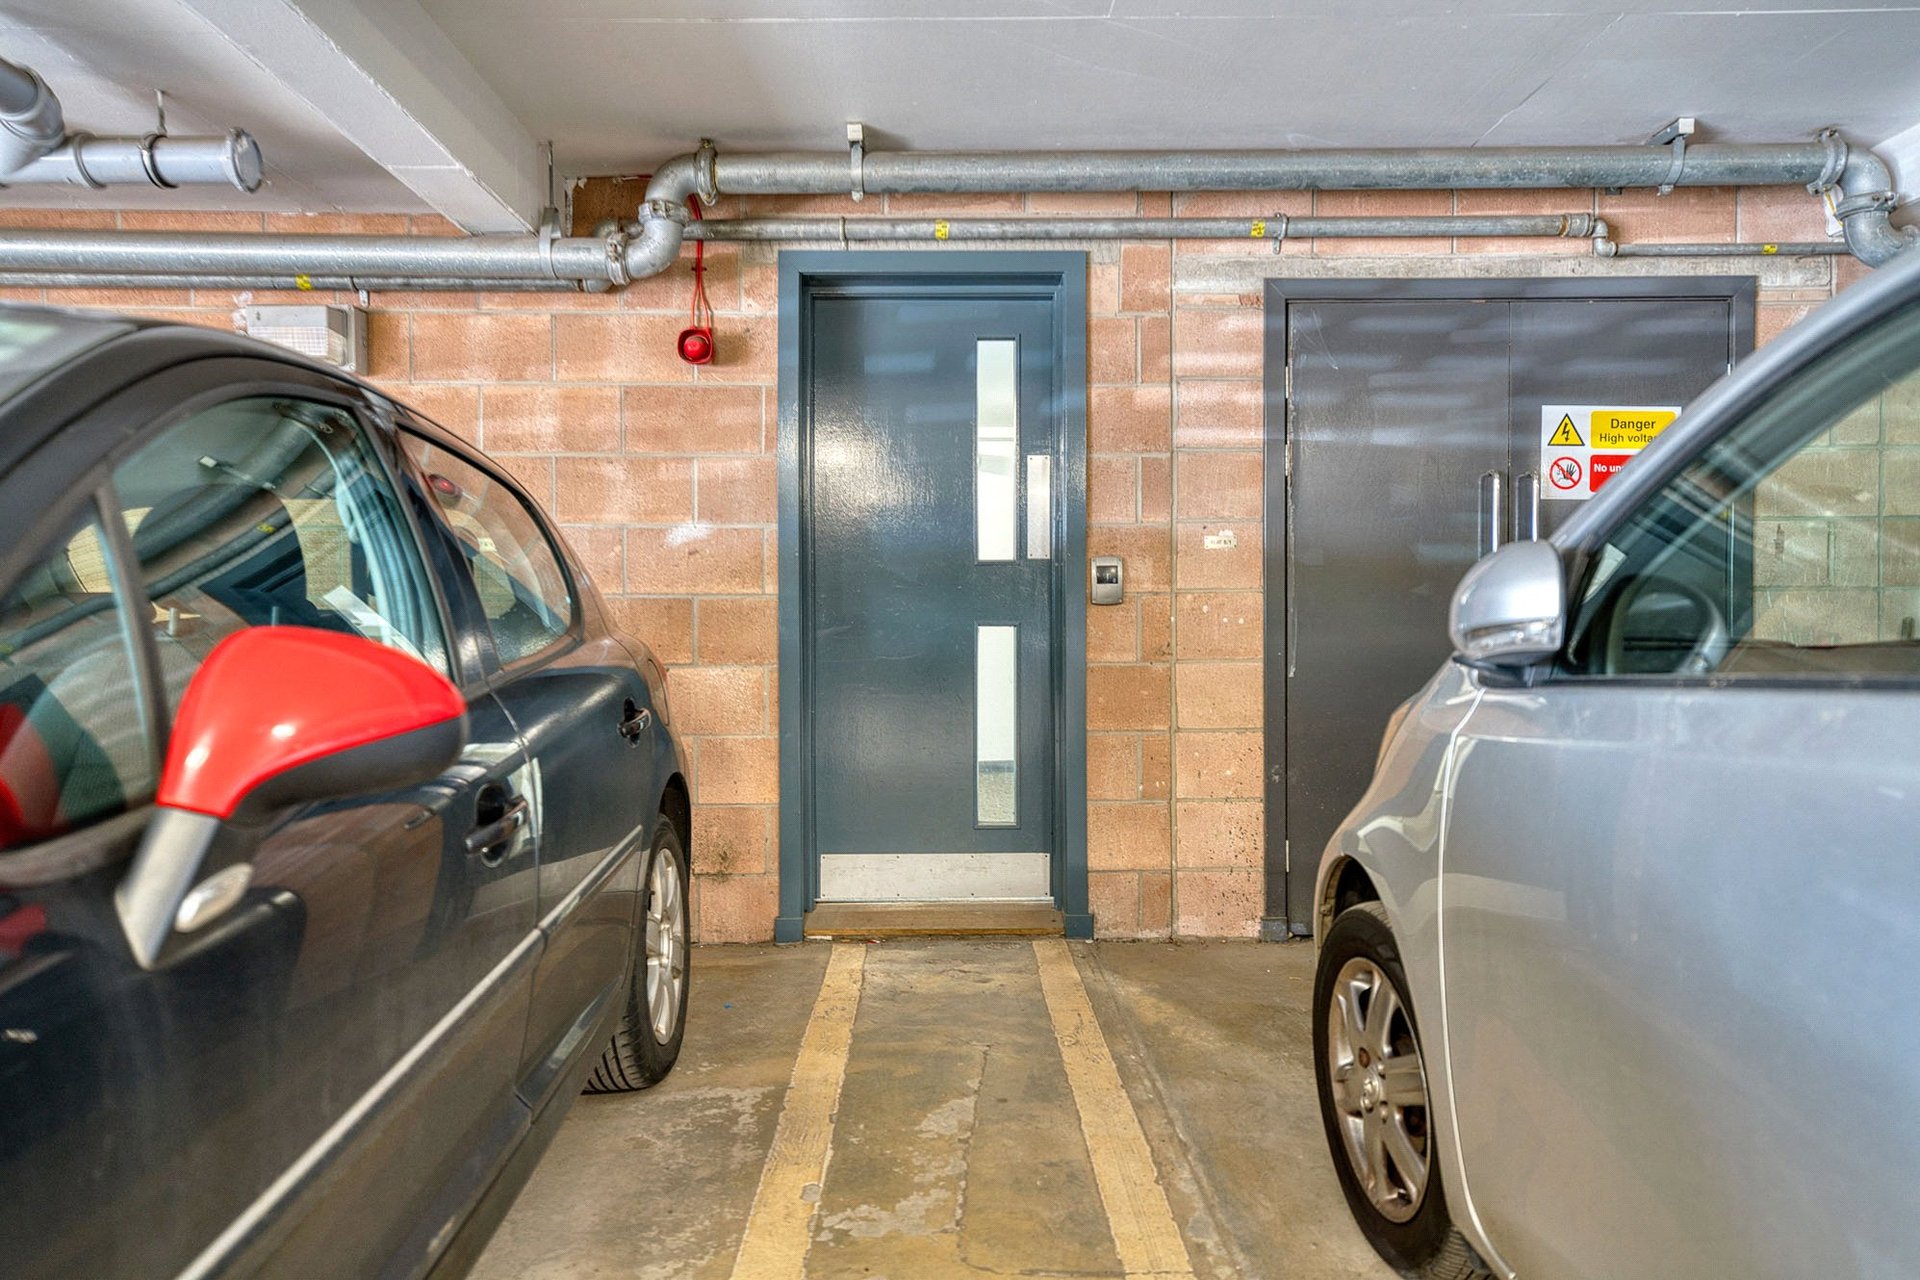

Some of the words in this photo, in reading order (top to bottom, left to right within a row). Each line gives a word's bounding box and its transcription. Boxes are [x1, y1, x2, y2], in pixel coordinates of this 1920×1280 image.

[1611, 418, 1656, 432] Danger
[1600, 433, 1625, 444] High
[1628, 434, 1656, 443] volta
[1594, 463, 1608, 473] No
[1609, 465, 1624, 473] un
